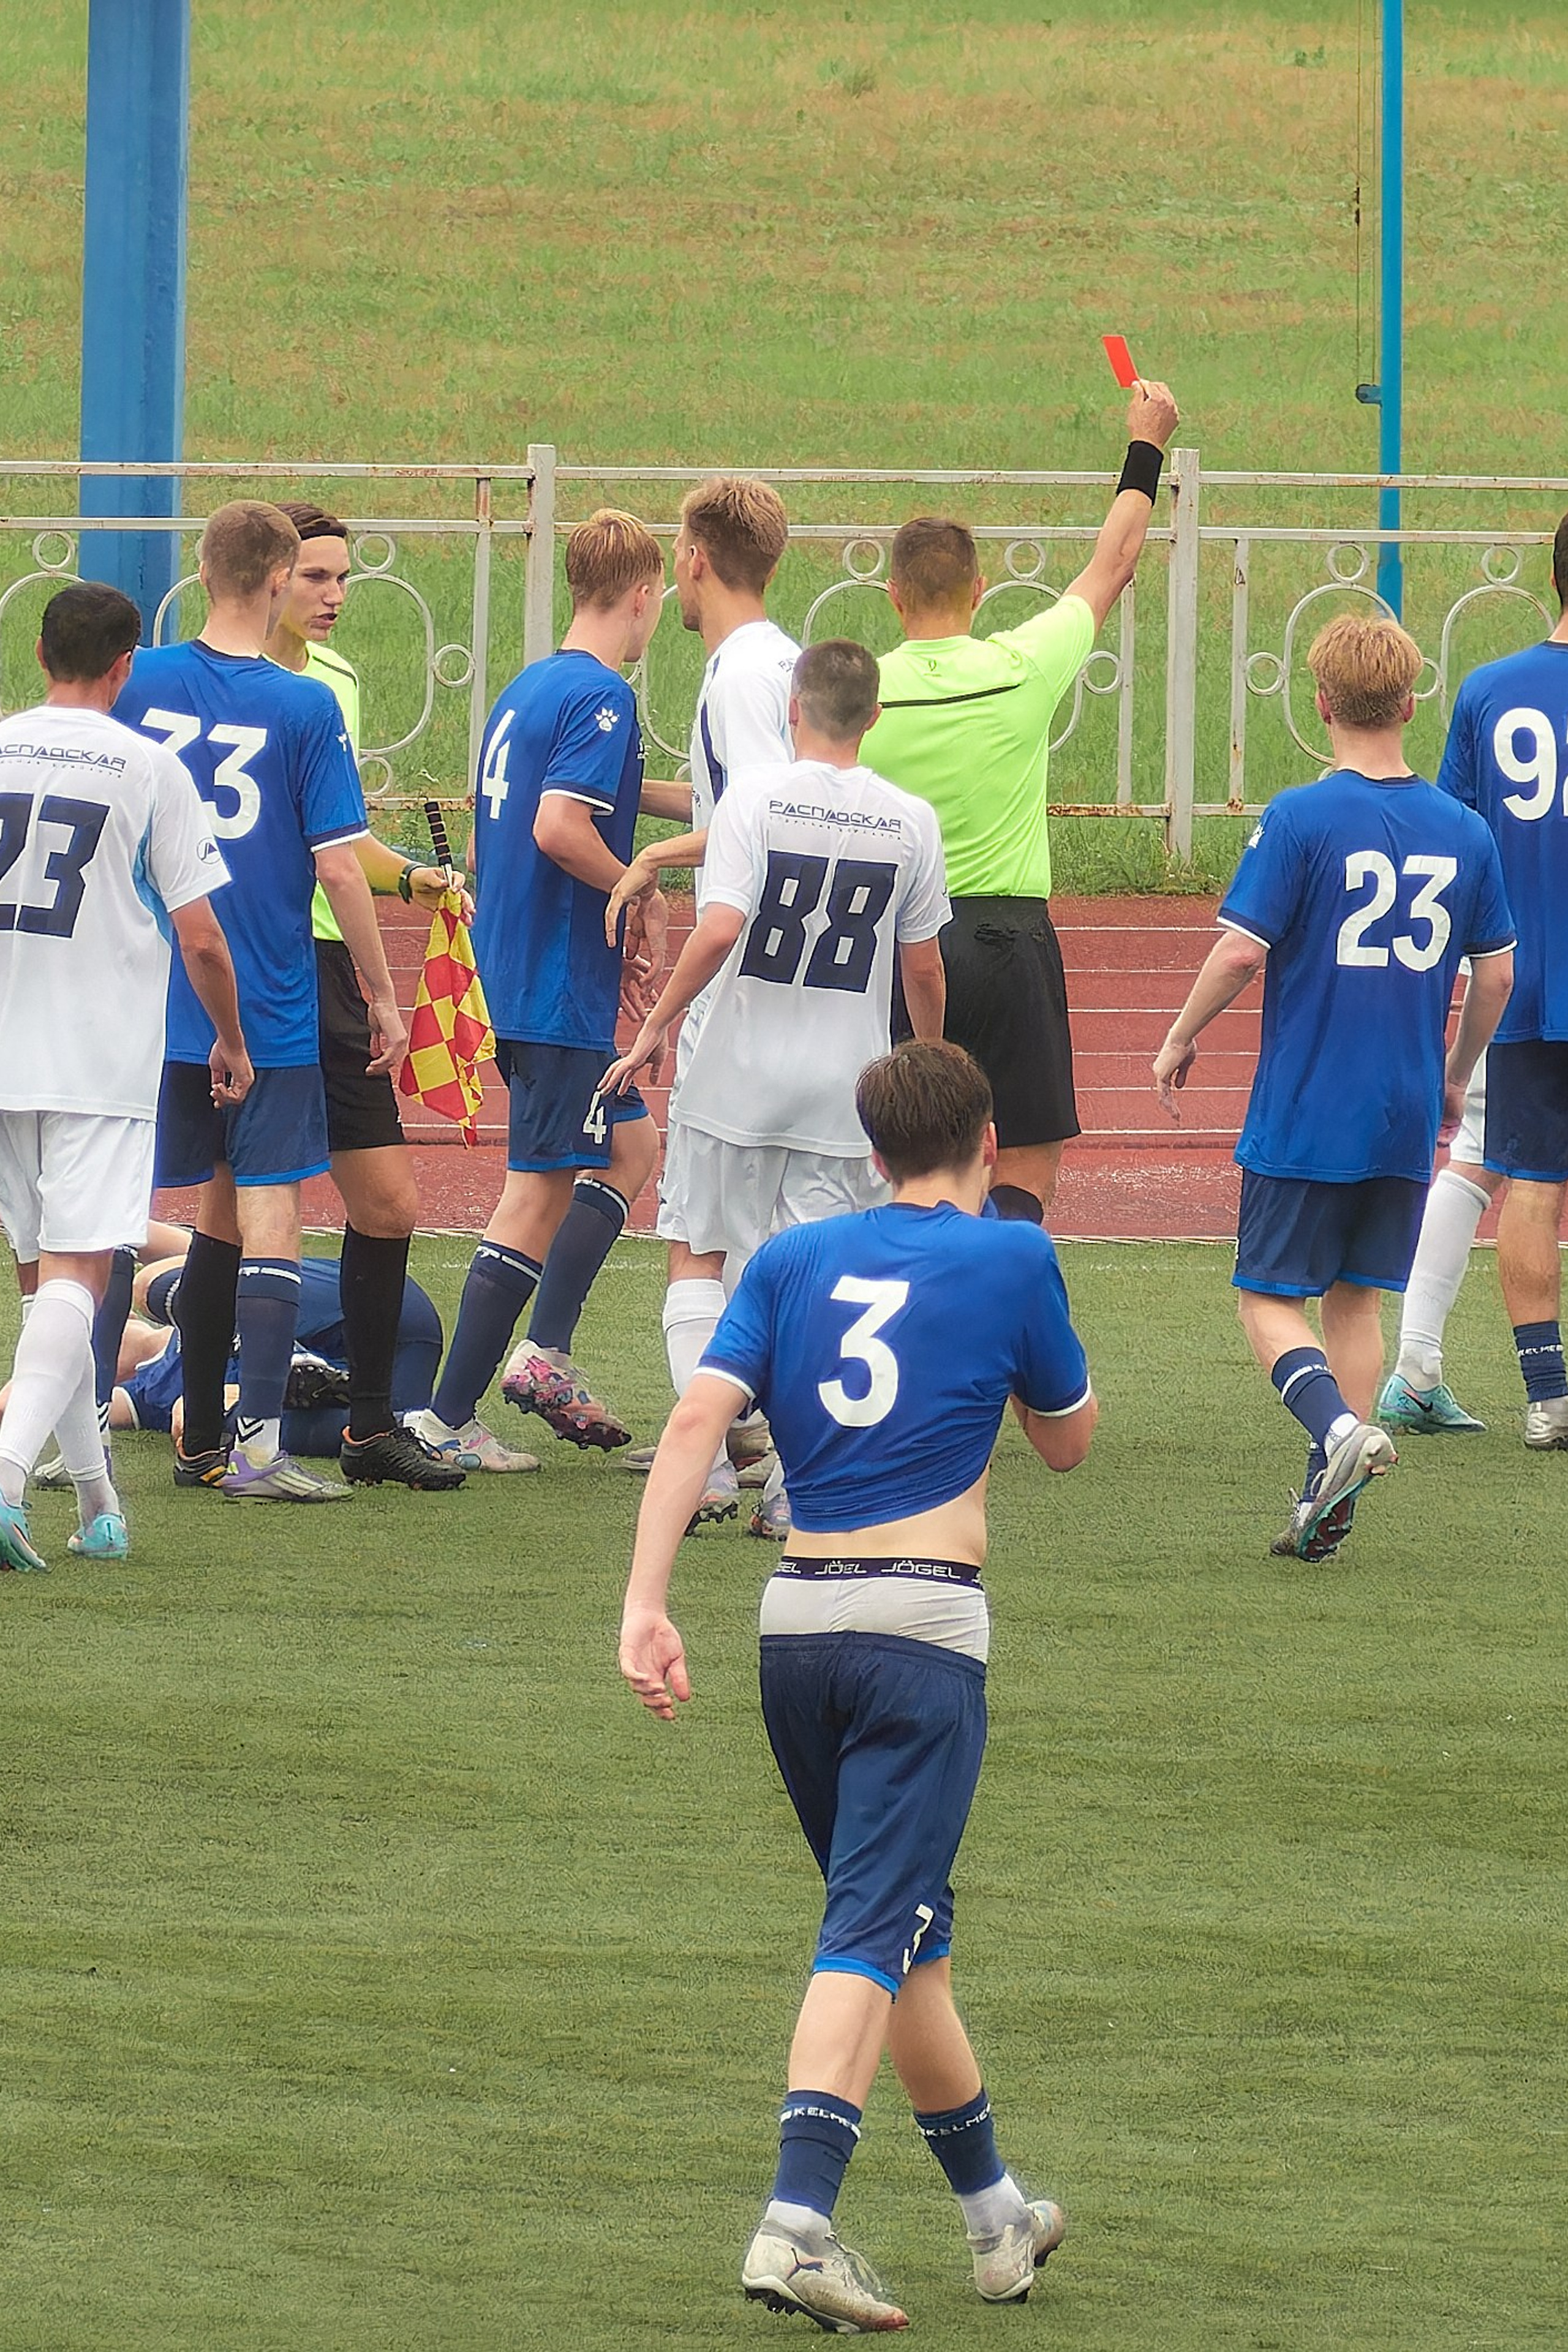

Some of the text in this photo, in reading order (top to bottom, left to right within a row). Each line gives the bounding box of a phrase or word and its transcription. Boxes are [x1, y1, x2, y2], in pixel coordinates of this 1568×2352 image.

[0, 744, 126, 772] СПАДСКАЯ
[482, 709, 516, 820] 4
[1494, 707, 1568, 821] 9
[737, 850, 898, 993] 88
[1337, 851, 1457, 971] 23
[583, 1091, 606, 1144] 4
[818, 1276, 910, 1428] 3
[881, 1560, 961, 1580] JÖGEL
